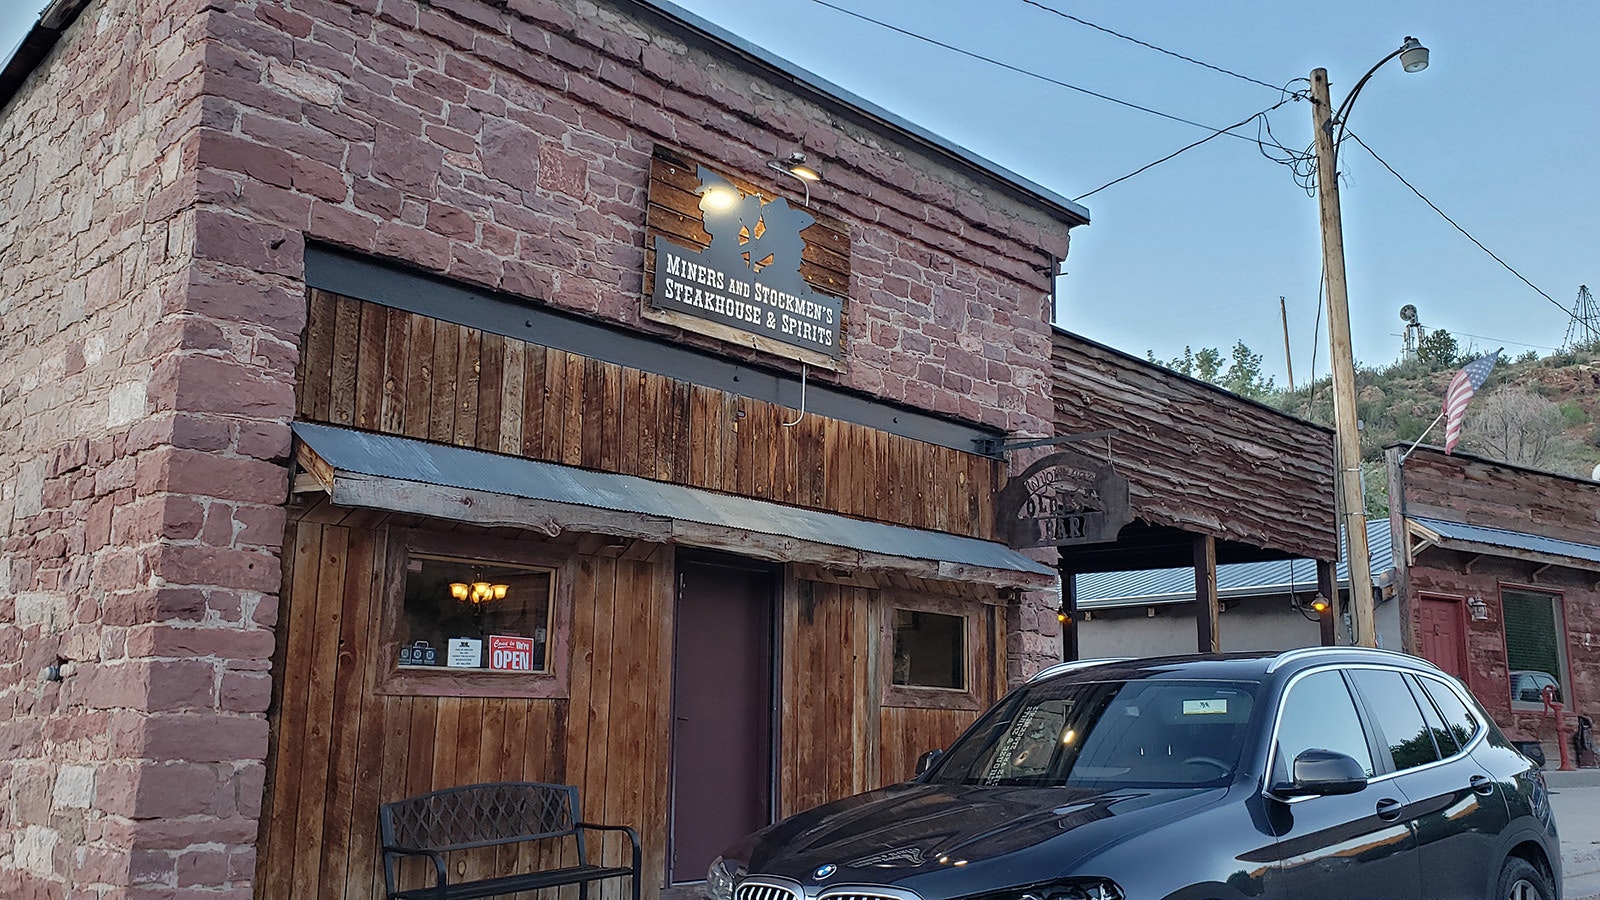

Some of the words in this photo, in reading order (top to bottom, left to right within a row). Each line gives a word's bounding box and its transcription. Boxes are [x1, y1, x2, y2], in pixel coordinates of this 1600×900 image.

[665, 278, 762, 325] STEAKHOUSE
[766, 312, 776, 330] &
[781, 314, 832, 346] SPIRITS
[666, 253, 724, 289] MINERS
[729, 278, 750, 298] AND
[754, 283, 834, 325] STOCKMEN'S
[494, 650, 529, 670] OPEN
